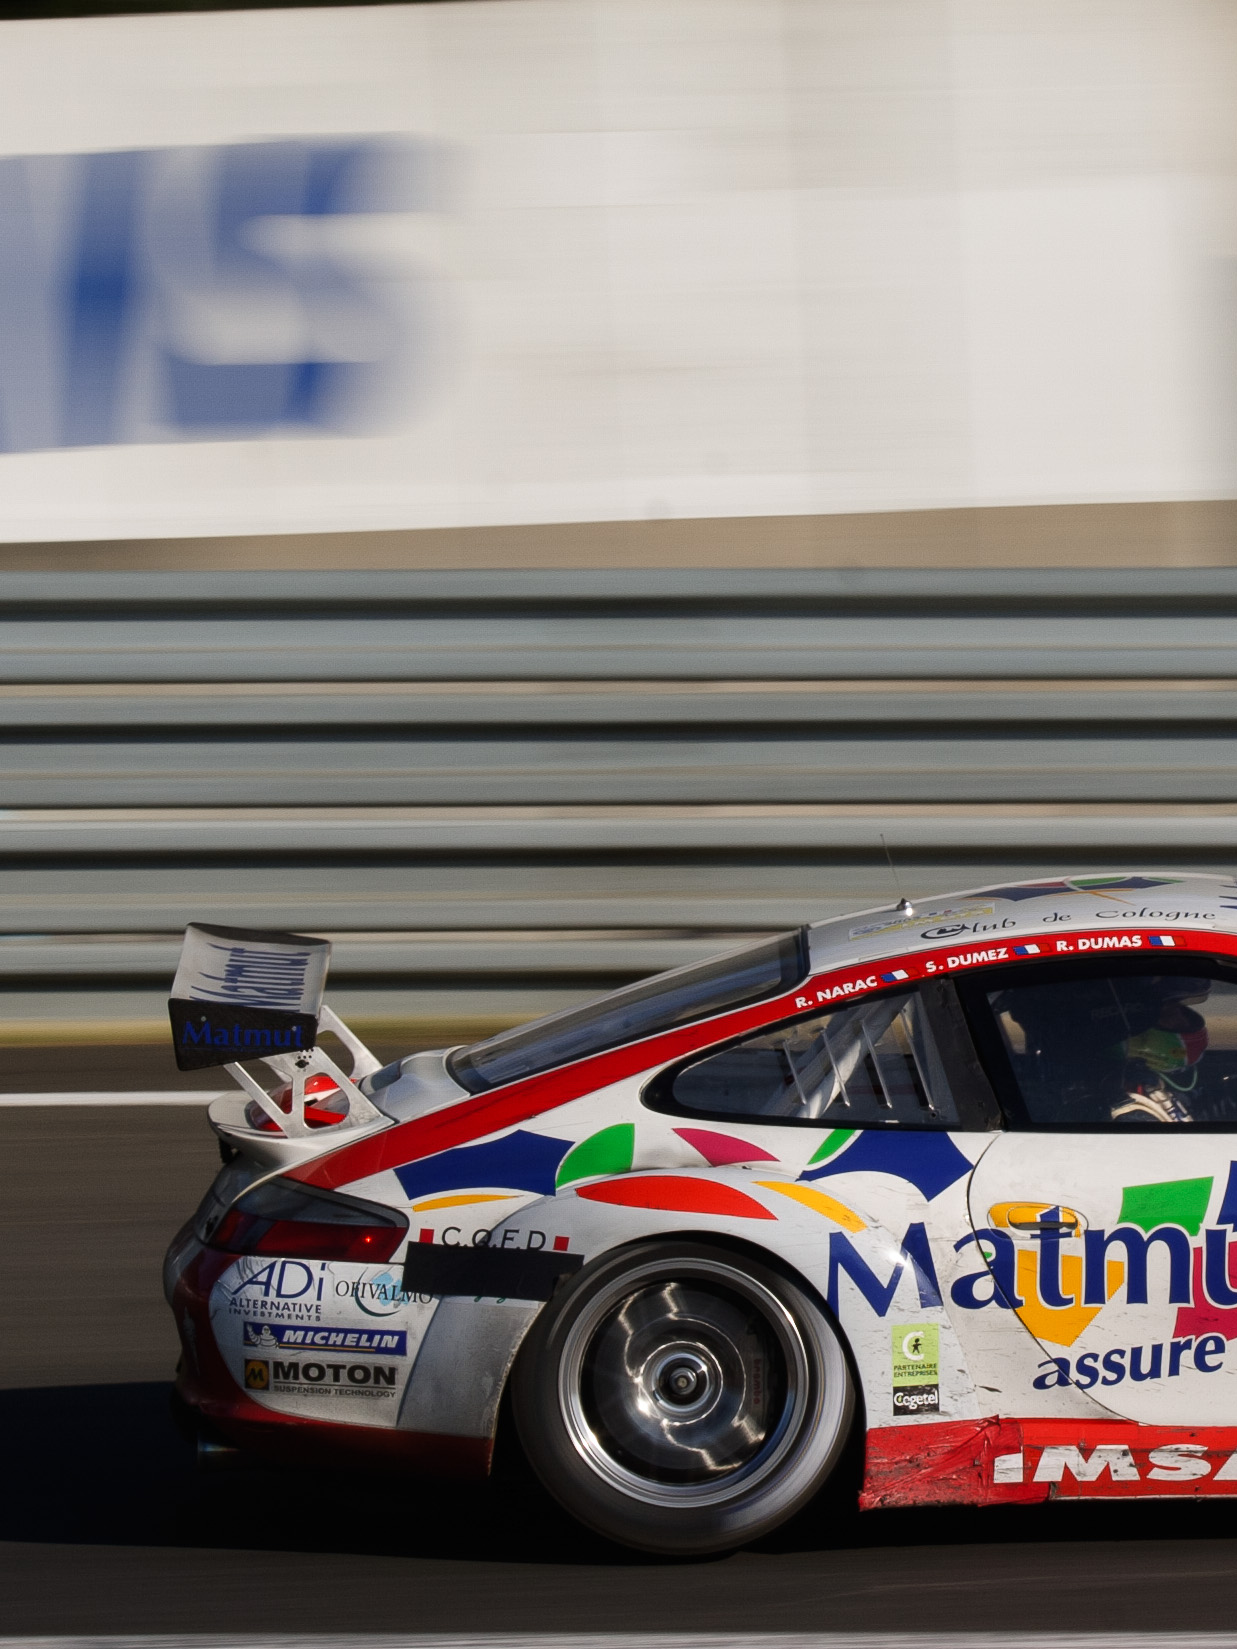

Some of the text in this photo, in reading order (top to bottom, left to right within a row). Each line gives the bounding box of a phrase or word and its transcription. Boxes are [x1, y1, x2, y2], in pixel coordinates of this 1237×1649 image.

[1043, 912, 1071, 923] de
[1096, 907, 1215, 922] Cologne
[1056, 935, 1142, 952] R. DUMAS
[926, 948, 1008, 973] S. DUMEZ
[795, 976, 878, 1008] R. NARAC
[182, 1021, 304, 1048] Matmut
[229, 1298, 322, 1314] ALTERNATIVE
[229, 1308, 321, 1322] INVESTMENTS
[282, 1330, 399, 1349] MICHELIN
[894, 1363, 937, 1371] PARTENAIRE
[1032, 1331, 1225, 1391] assure
[273, 1361, 396, 1386] MOTON
[274, 1385, 396, 1399] SUSPENSION TECHNOLOGY
[894, 1389, 938, 1409] Cegetel
